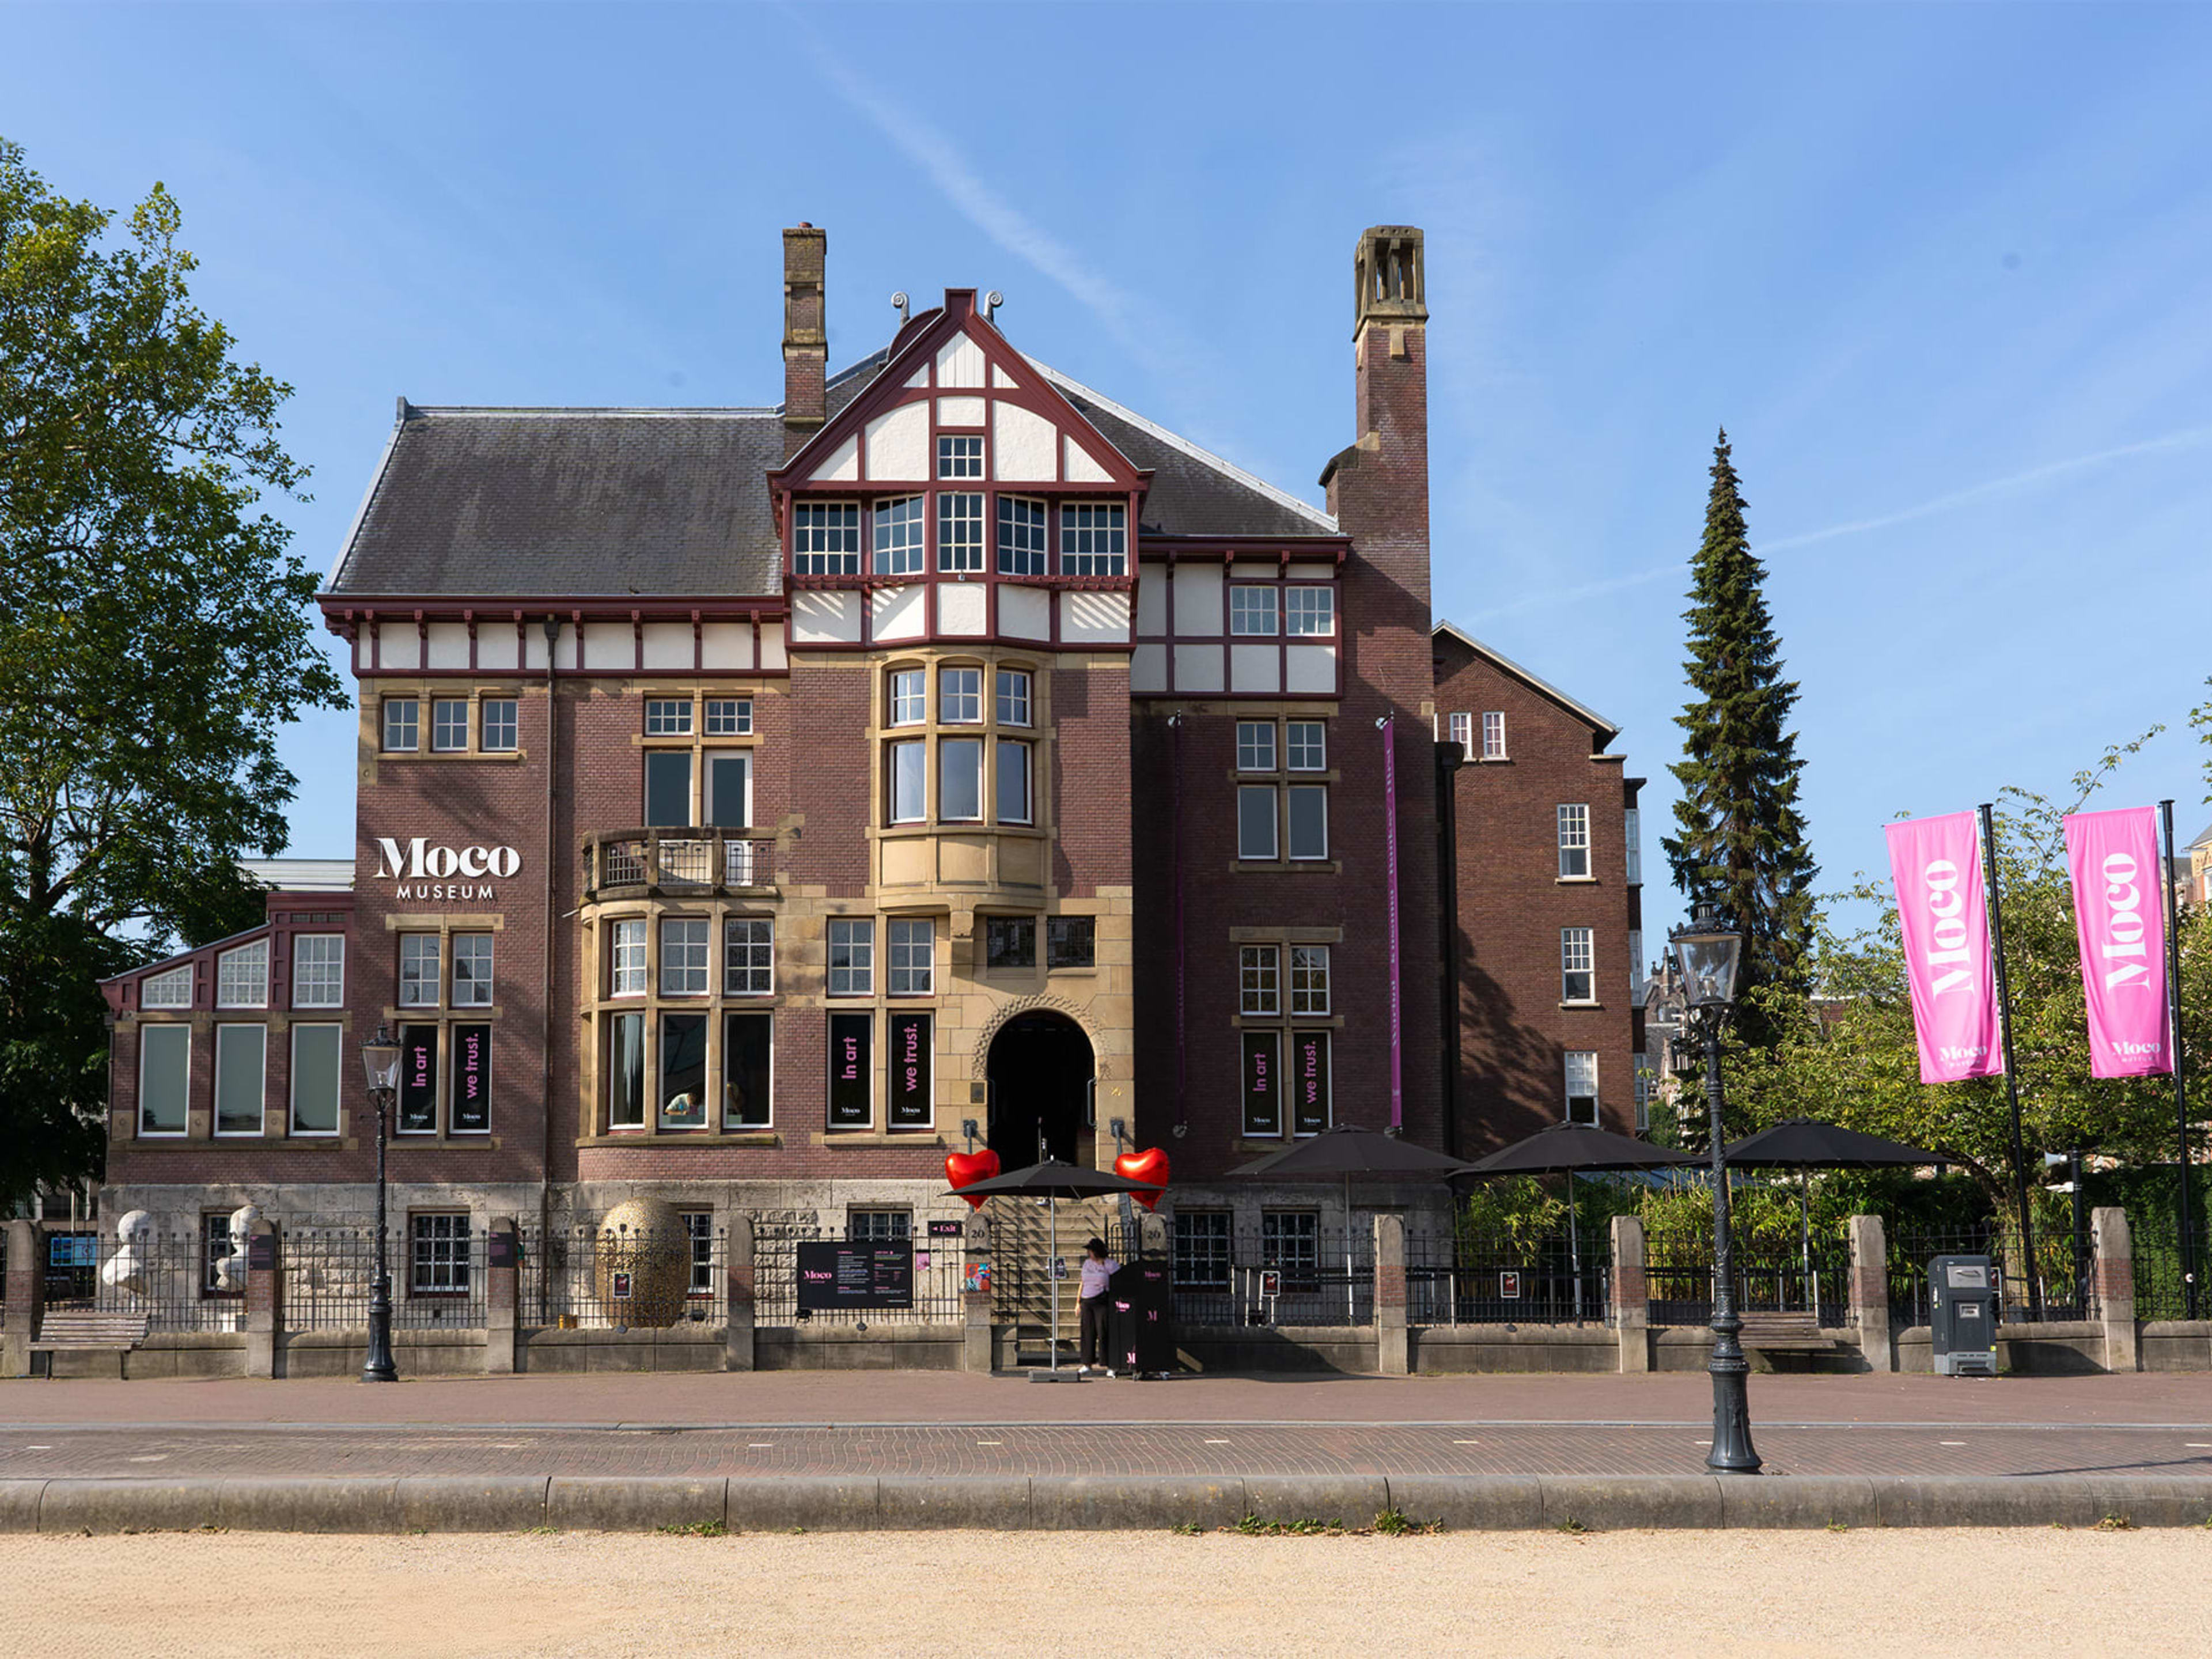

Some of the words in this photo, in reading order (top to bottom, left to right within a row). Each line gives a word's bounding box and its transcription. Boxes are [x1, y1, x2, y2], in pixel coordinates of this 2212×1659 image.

[372, 838, 520, 878] Moco
[396, 885, 494, 899] MUSEUM
[1926, 859, 1975, 1001] Moco
[2102, 853, 2151, 995] Moco
[465, 1033, 479, 1071] trust.
[843, 1037, 857, 1061] art
[903, 1022, 918, 1063] trust.
[1939, 1046, 1987, 1062] Moco
[2111, 1041, 2161, 1055] Moco
[414, 1046, 427, 1070] art
[1254, 1053, 1267, 1075] art
[1304, 1040, 1317, 1078] trust.
[411, 1073, 427, 1087] In
[841, 1065, 857, 1079] In
[906, 1067, 917, 1092] we
[467, 1075, 478, 1099] we
[1252, 1078, 1267, 1092] In
[1306, 1080, 1317, 1104] we
[971, 1228, 985, 1239] 20
[804, 1270, 832, 1279] Moco
